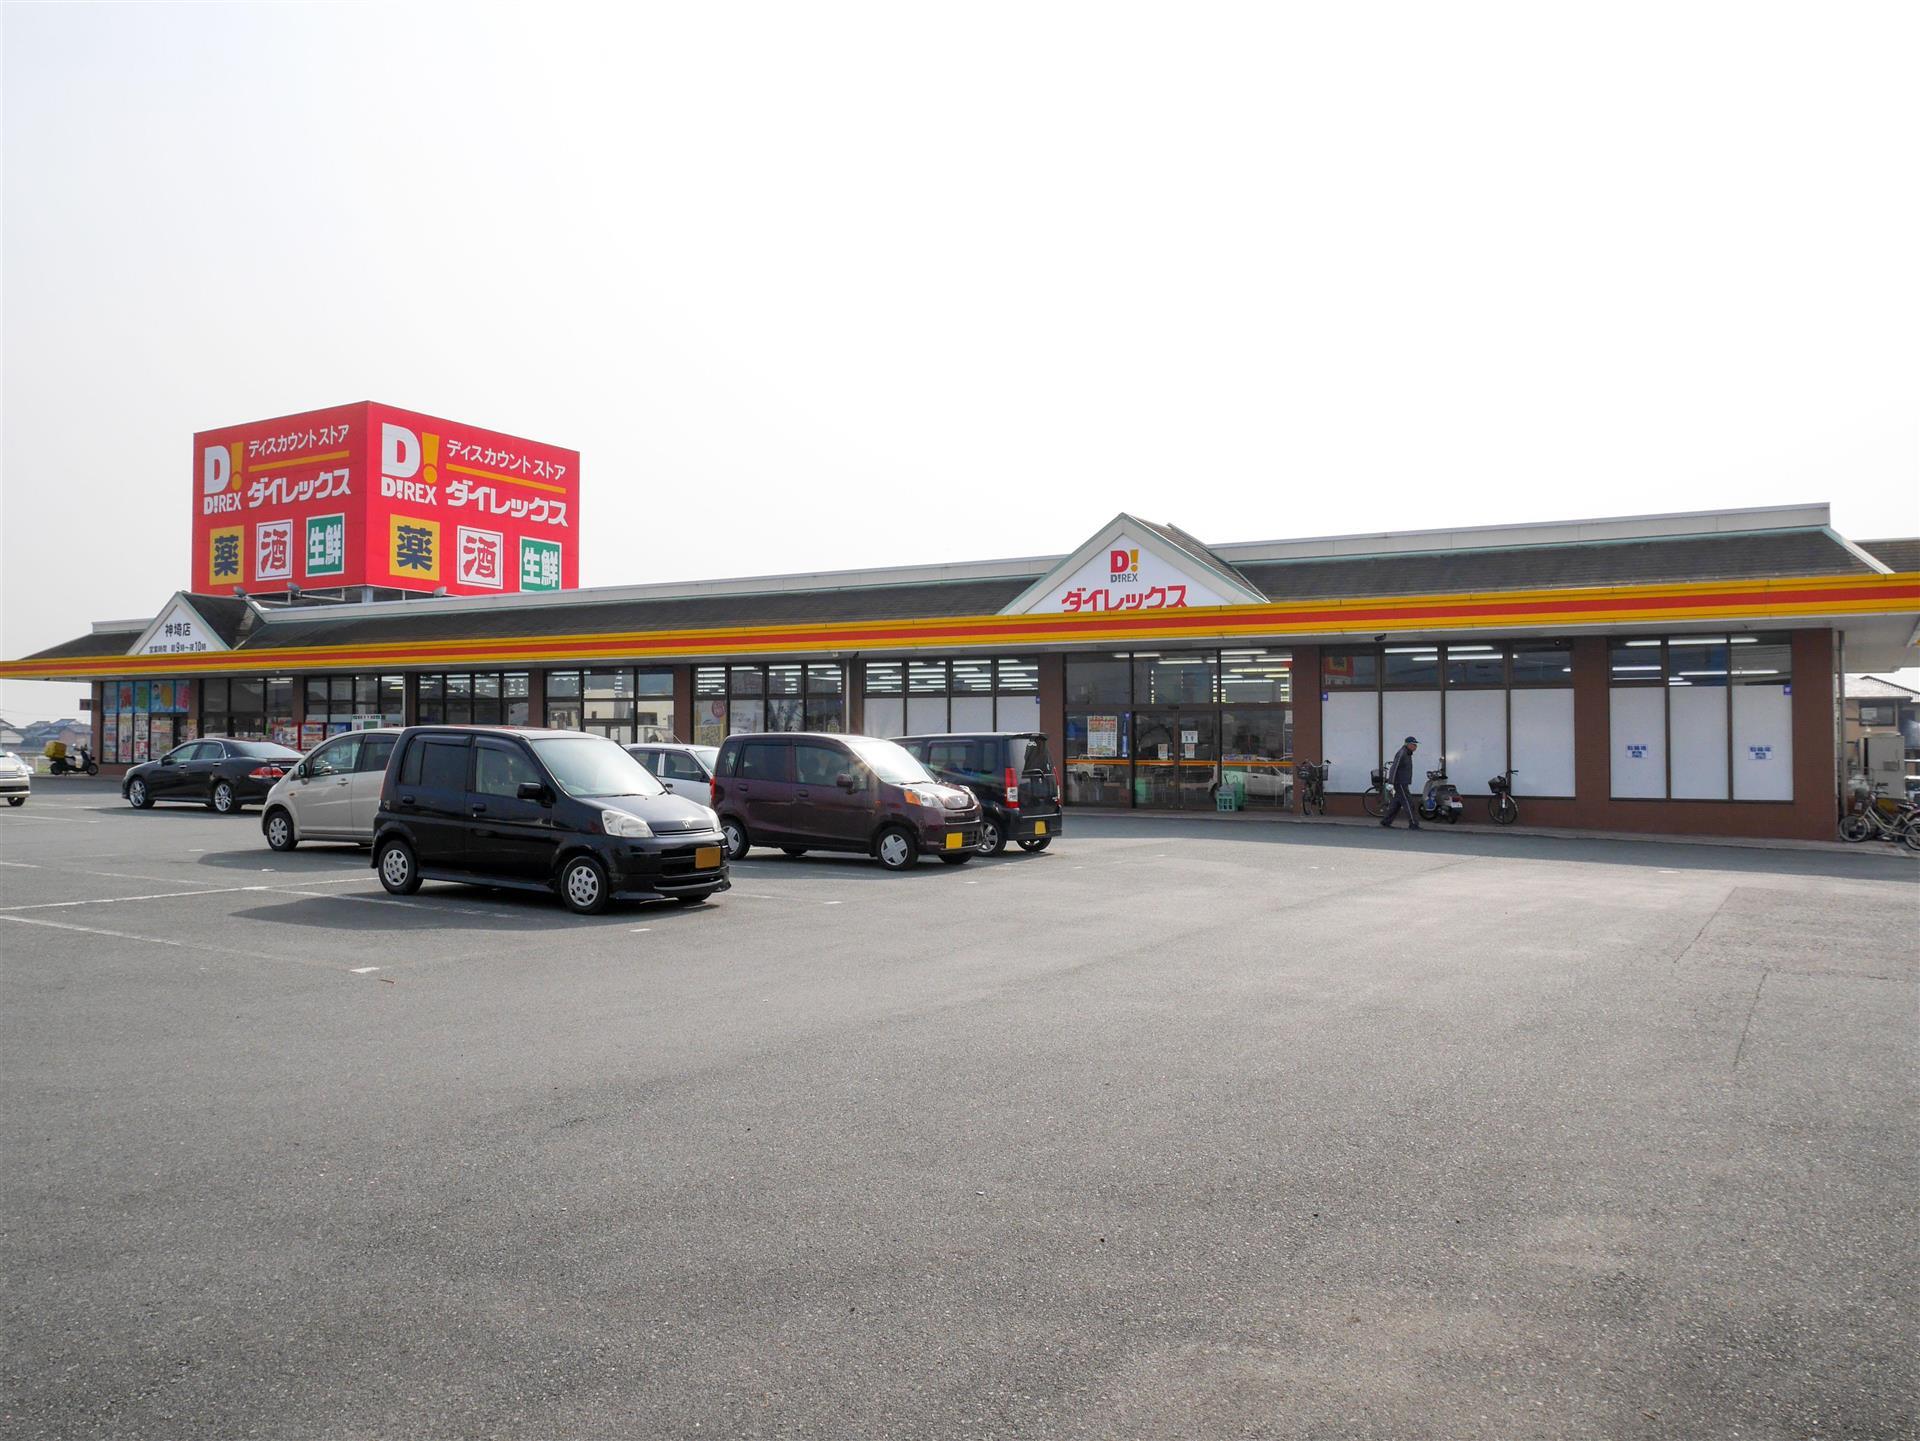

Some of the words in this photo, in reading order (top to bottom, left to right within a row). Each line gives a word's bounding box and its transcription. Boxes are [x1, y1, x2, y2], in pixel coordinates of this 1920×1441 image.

[247, 468, 351, 509] ダイレックス
[445, 479, 568, 528] ダイレックス
[214, 534, 239, 577] 薬
[260, 528, 288, 574] 酒
[308, 523, 342, 566] 生鮮
[397, 525, 433, 572] 薬
[462, 536, 497, 580] 酒
[522, 546, 559, 589] 生鮮
[1061, 585, 1188, 613] ダイレックス
